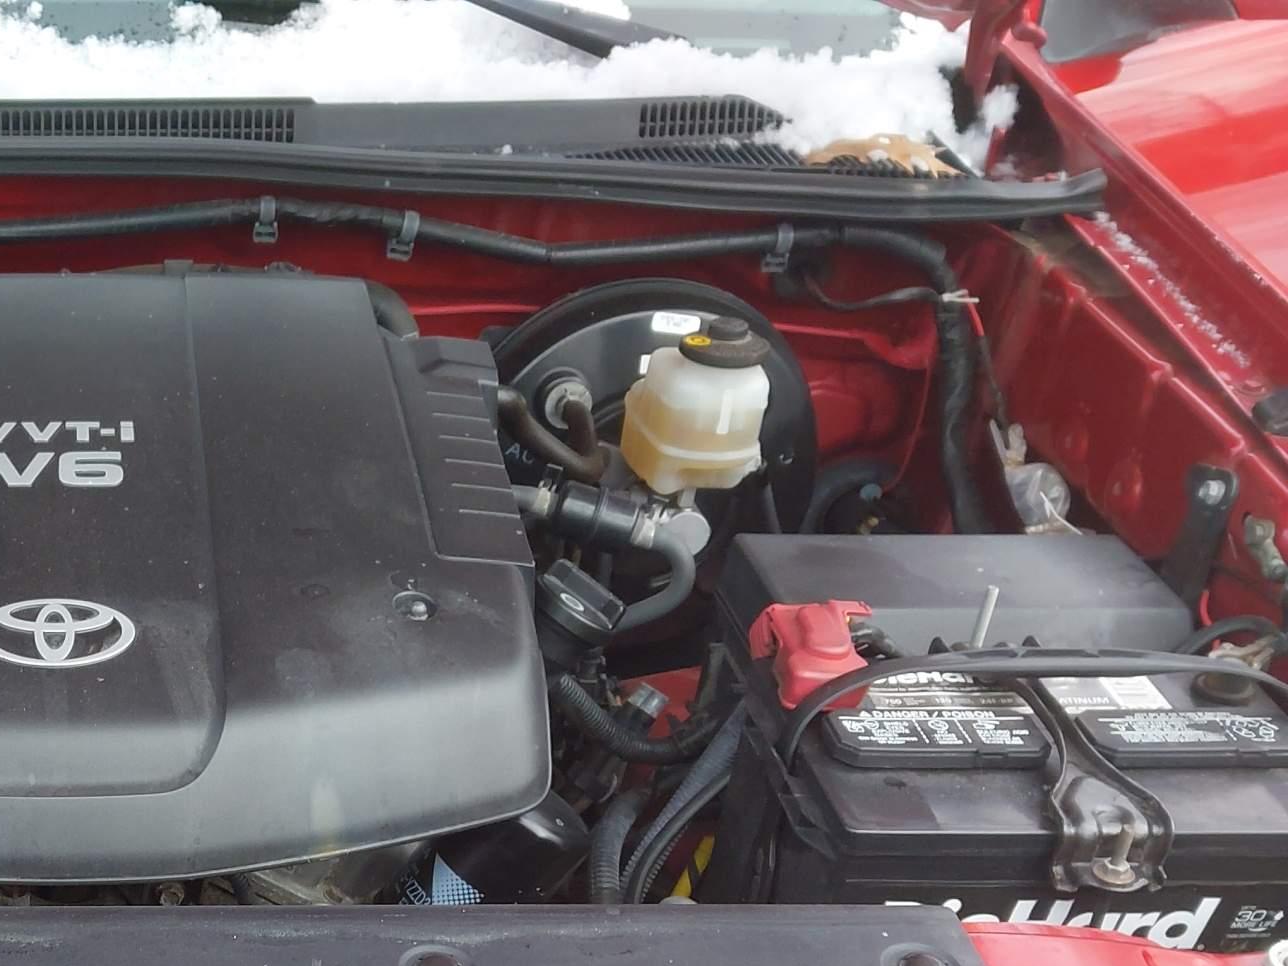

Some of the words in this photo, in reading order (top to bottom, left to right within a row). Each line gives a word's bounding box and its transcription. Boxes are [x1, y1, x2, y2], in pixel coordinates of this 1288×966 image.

[872, 671, 984, 685] ieHar
[1058, 696, 1110, 705] ATINUM
[871, 710, 930, 719] DANGER
[941, 710, 996, 719] POISON
[885, 897, 1222, 949] Hard
